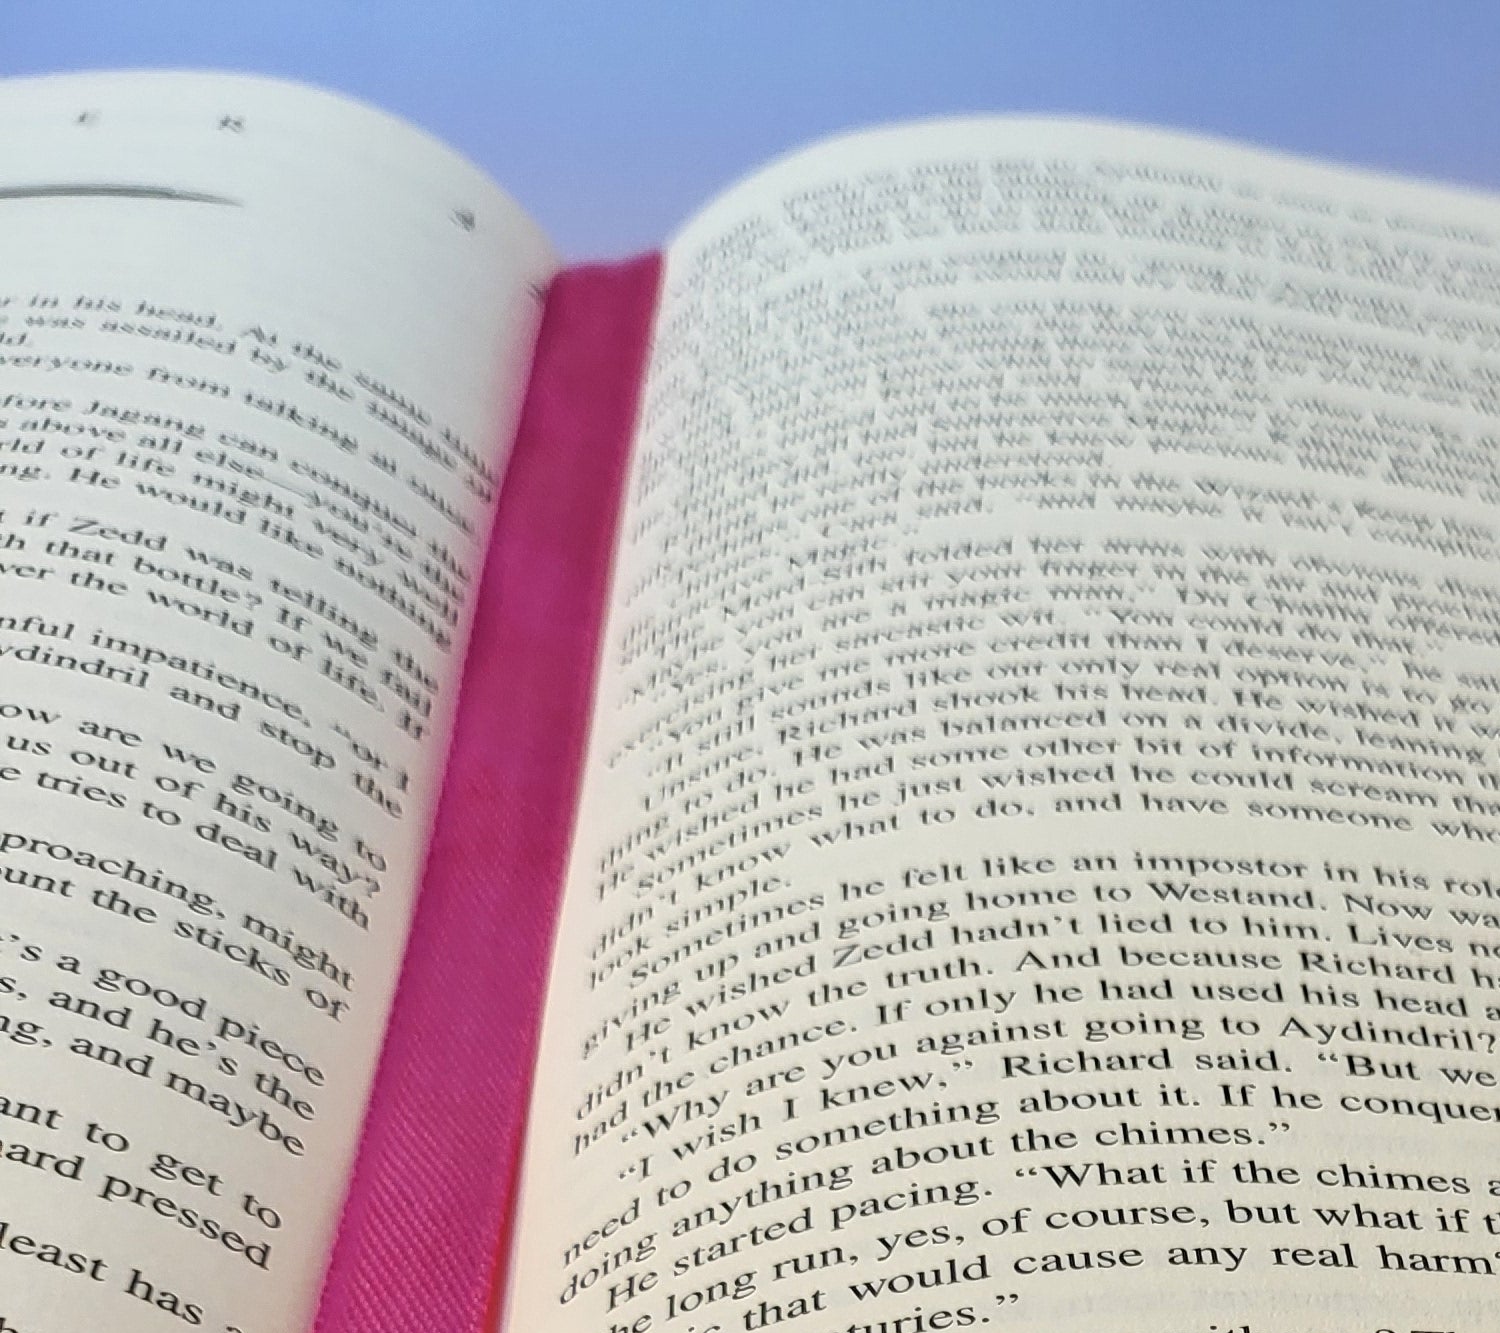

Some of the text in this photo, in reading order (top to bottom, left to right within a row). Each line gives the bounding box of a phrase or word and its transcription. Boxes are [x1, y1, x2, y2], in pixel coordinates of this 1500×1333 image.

[35, 771, 370, 931] tries to deal with
[240, 913, 353, 992] might
[924, 977, 1286, 1017] only he had used
[46, 991, 316, 1121] and he’s the
[54, 955, 326, 1087] a good piece
[620, 1090, 730, 1143] “Why
[744, 1065, 806, 1097] are
[820, 1042, 899, 1081] you
[915, 1018, 1070, 1056] against
[1083, 1011, 1206, 1043] going
[1218, 1015, 1262, 1036] to
[67, 1037, 306, 1157] and maybe
[618, 1156, 653, 1181] “I
[670, 1112, 763, 1161] wish
[781, 1097, 799, 1121] I
[818, 1059, 974, 1111] knew,”
[1000, 1046, 1176, 1079] Richard
[1194, 1048, 1293, 1073] said.
[1316, 1051, 1422, 1081] “But
[1437, 1067, 1499, 1087] we
[0, 1139, 273, 1271] ard pressed
[84, 1122, 131, 1153] to
[147, 1153, 225, 1197] get
[240, 1193, 283, 1229] to
[558, 1120, 1291, 1305] doing anything about the chimes.”
[562, 1196, 641, 1266] need
[655, 1179, 693, 1207] to
[706, 1153, 758, 1183] do
[774, 1100, 1002, 1161] something
[1018, 1087, 1143, 1114] about
[1158, 1083, 1201, 1107] it.
[1217, 1083, 1258, 1107] If
[1270, 1084, 1324, 1110] he
[605, 1271, 660, 1314] He
[672, 1206, 816, 1277] started
[829, 1180, 994, 1232] pacing.
[1014, 1161, 1169, 1189] “What
[1180, 1158, 1219, 1184] if
[1230, 1159, 1302, 1185] the
[1315, 1162, 1472, 1195] chimes
[0, 1221, 110, 1282] least
[122, 1268, 205, 1326] has
[664, 1270, 759, 1333] long
[771, 1246, 860, 1282] run,
[875, 1225, 966, 1262] yes,
[980, 1207, 1033, 1237] of
[1044, 1205, 1211, 1230] course,
[1222, 1198, 1302, 1225] but
[1310, 1202, 1425, 1231] what
[1434, 1207, 1471, 1234] if
[741, 1289, 828, 1332] that
[846, 1254, 993, 1302] would
[1012, 1248, 1146, 1275] cause
[1166, 1246, 1249, 1273] any
[1269, 1242, 1360, 1269] real
